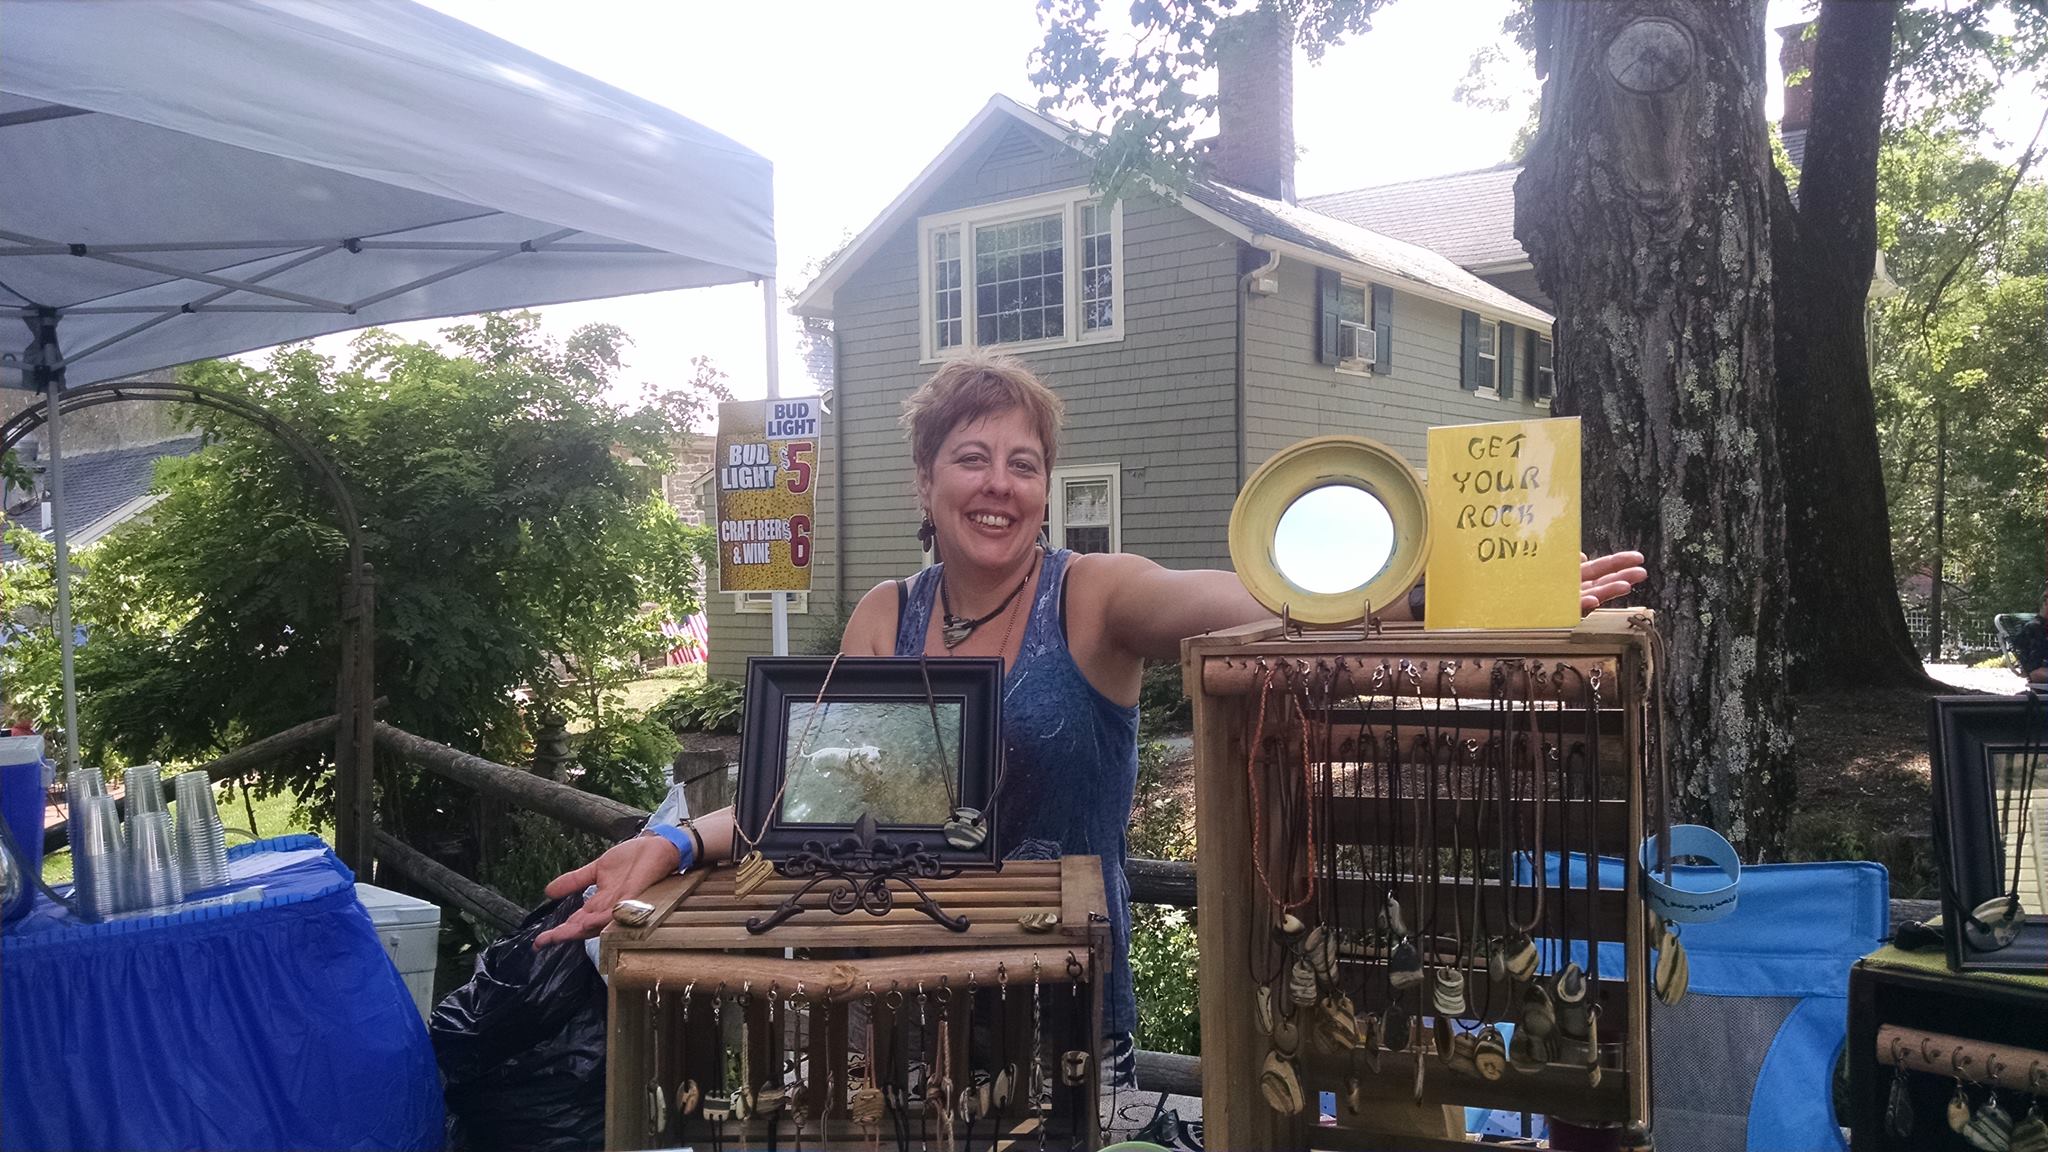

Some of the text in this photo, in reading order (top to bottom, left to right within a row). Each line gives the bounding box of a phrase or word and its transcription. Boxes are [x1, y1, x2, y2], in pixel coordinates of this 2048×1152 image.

[774, 402, 810, 420] BUD
[767, 418, 817, 437] LIGHT
[729, 443, 770, 466] BUD
[1468, 433, 1527, 460] GET
[721, 465, 778, 490] LIGHT
[1452, 466, 1540, 494] YOUR
[1456, 504, 1535, 530] ROCK
[721, 518, 782, 542] CRAFT BEER
[733, 542, 771, 565] & WINE
[1477, 537, 1538, 562] ON!!
